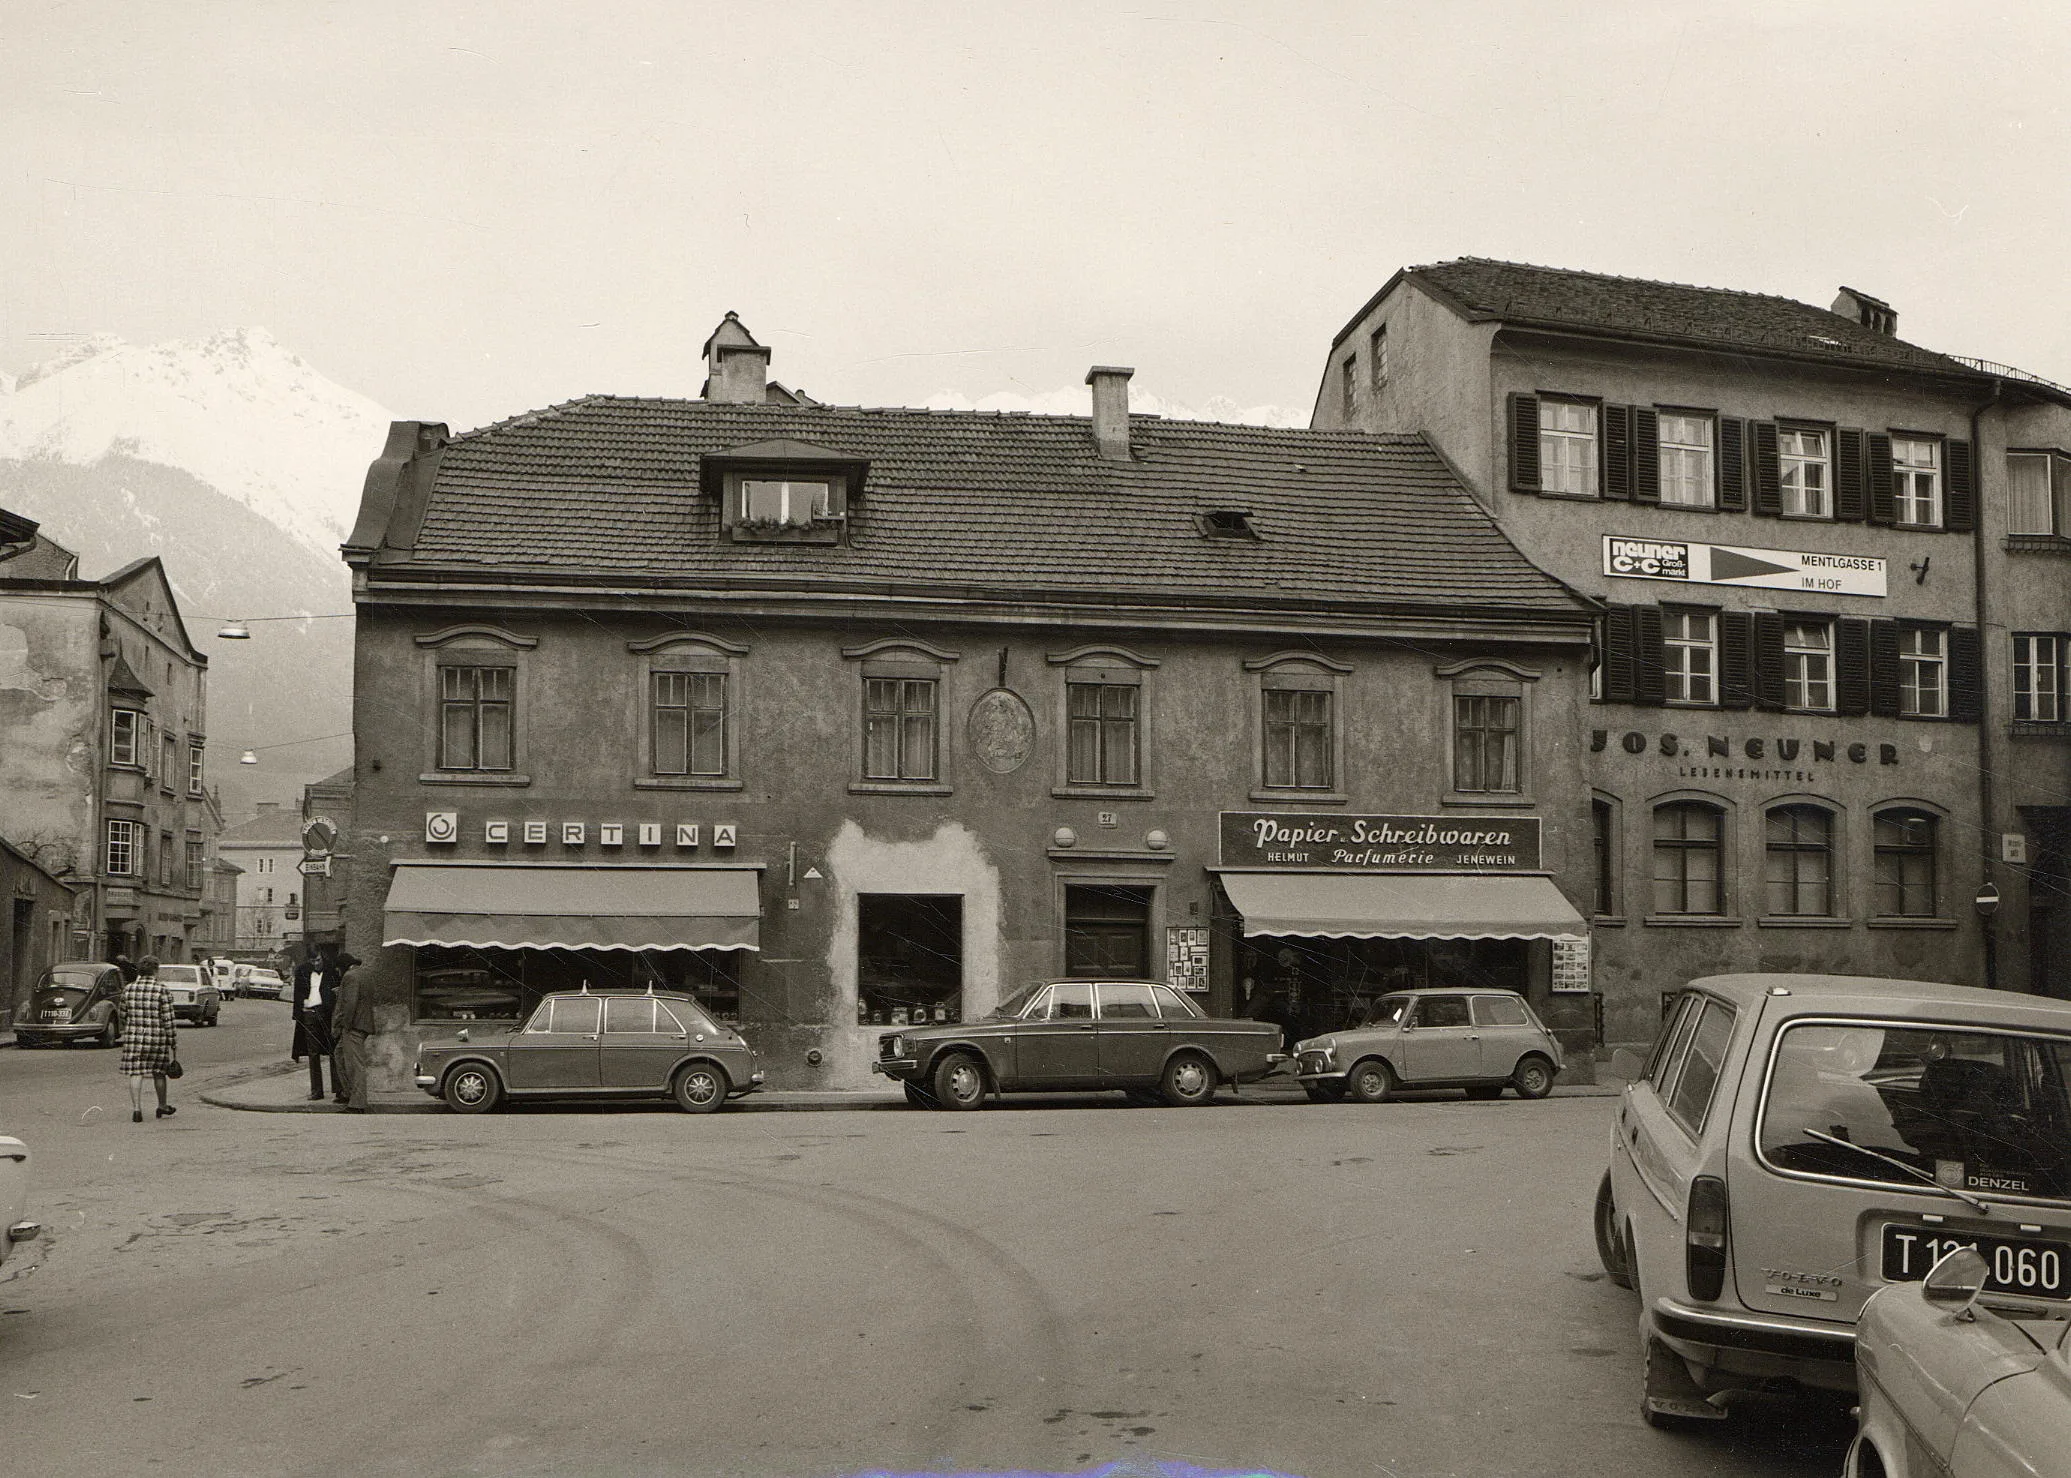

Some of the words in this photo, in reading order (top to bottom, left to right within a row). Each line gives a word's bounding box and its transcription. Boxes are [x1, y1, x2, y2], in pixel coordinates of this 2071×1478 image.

[1612, 541, 1686, 561] neuner
[1613, 556, 1661, 574] C+C
[1801, 554, 1875, 571] MENTLGASSE
[1876, 561, 1882, 571] 1
[1661, 568, 1687, 576] markt
[1801, 576, 1814, 588] IM
[1818, 578, 1842, 590] HOF
[1590, 729, 1690, 757] JOS.
[1679, 766, 1815, 782] LEBENSMITTEL
[487, 823, 736, 846] CERTINA
[1253, 818, 1339, 849] Papier
[1350, 819, 1512, 846] Schreibwaren
[1267, 852, 1310, 862] HELMUT
[1331, 848, 1435, 866] Parfumerie
[1456, 854, 1516, 865] JENEWEIN
[1968, 1176, 2030, 1191] DENZEL
[1895, 1234, 1918, 1274] T
[1760, 1267, 1843, 1287] VOLVO
[1780, 1286, 1794, 1295] de
[1795, 1288, 1822, 1298] Luxe
